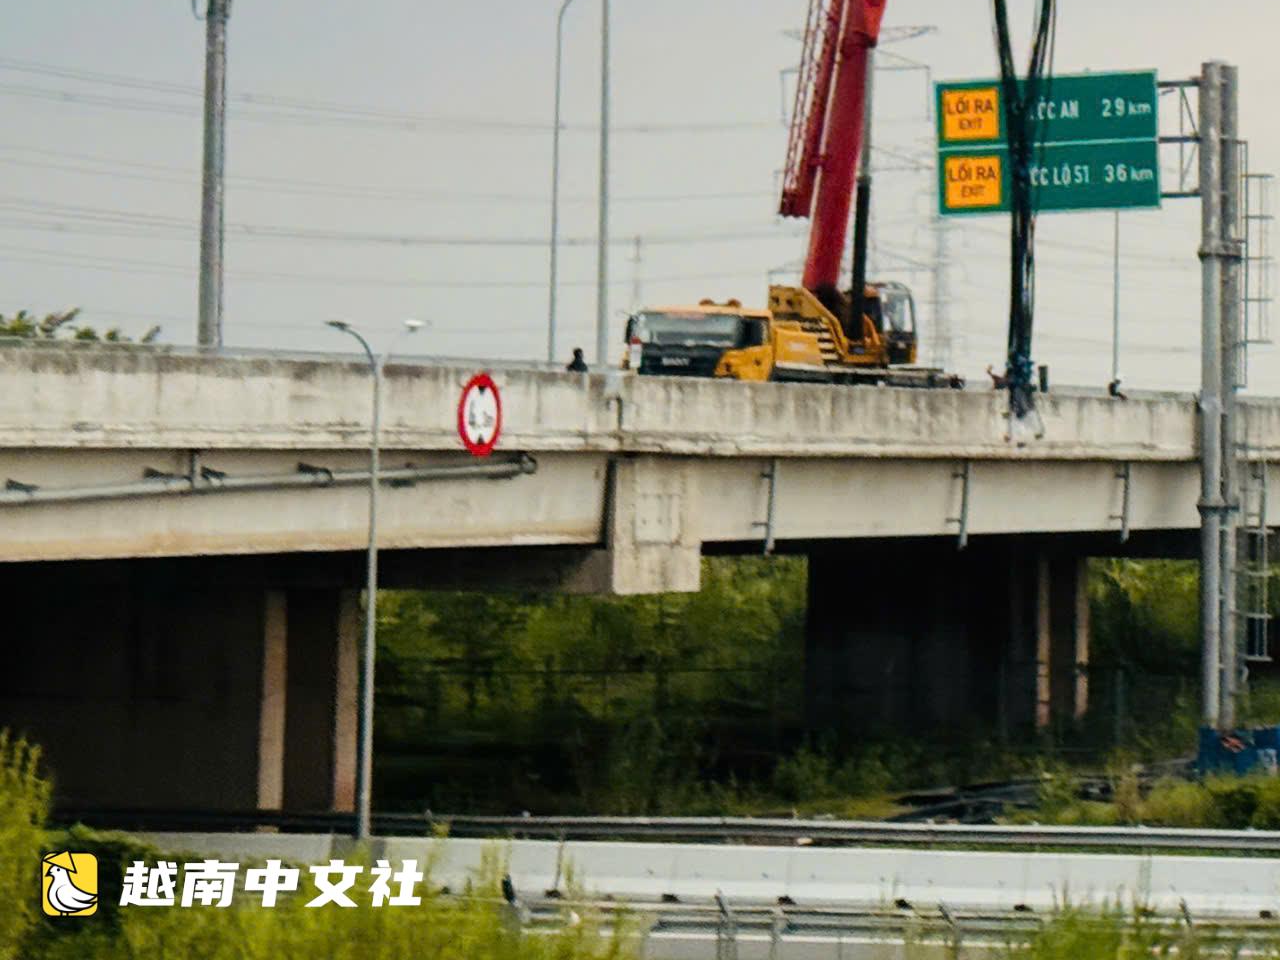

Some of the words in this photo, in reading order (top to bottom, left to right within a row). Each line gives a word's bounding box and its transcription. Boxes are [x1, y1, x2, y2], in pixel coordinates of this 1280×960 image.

[975, 98, 993, 113] RA
[1060, 100, 1079, 118] AN
[1102, 98, 1125, 117] 29
[1128, 101, 1152, 115] km
[959, 117, 982, 130] EXIT
[977, 164, 996, 180] RA
[1104, 164, 1128, 182] 36
[1130, 166, 1153, 181] km
[961, 184, 985, 198] EXIT
